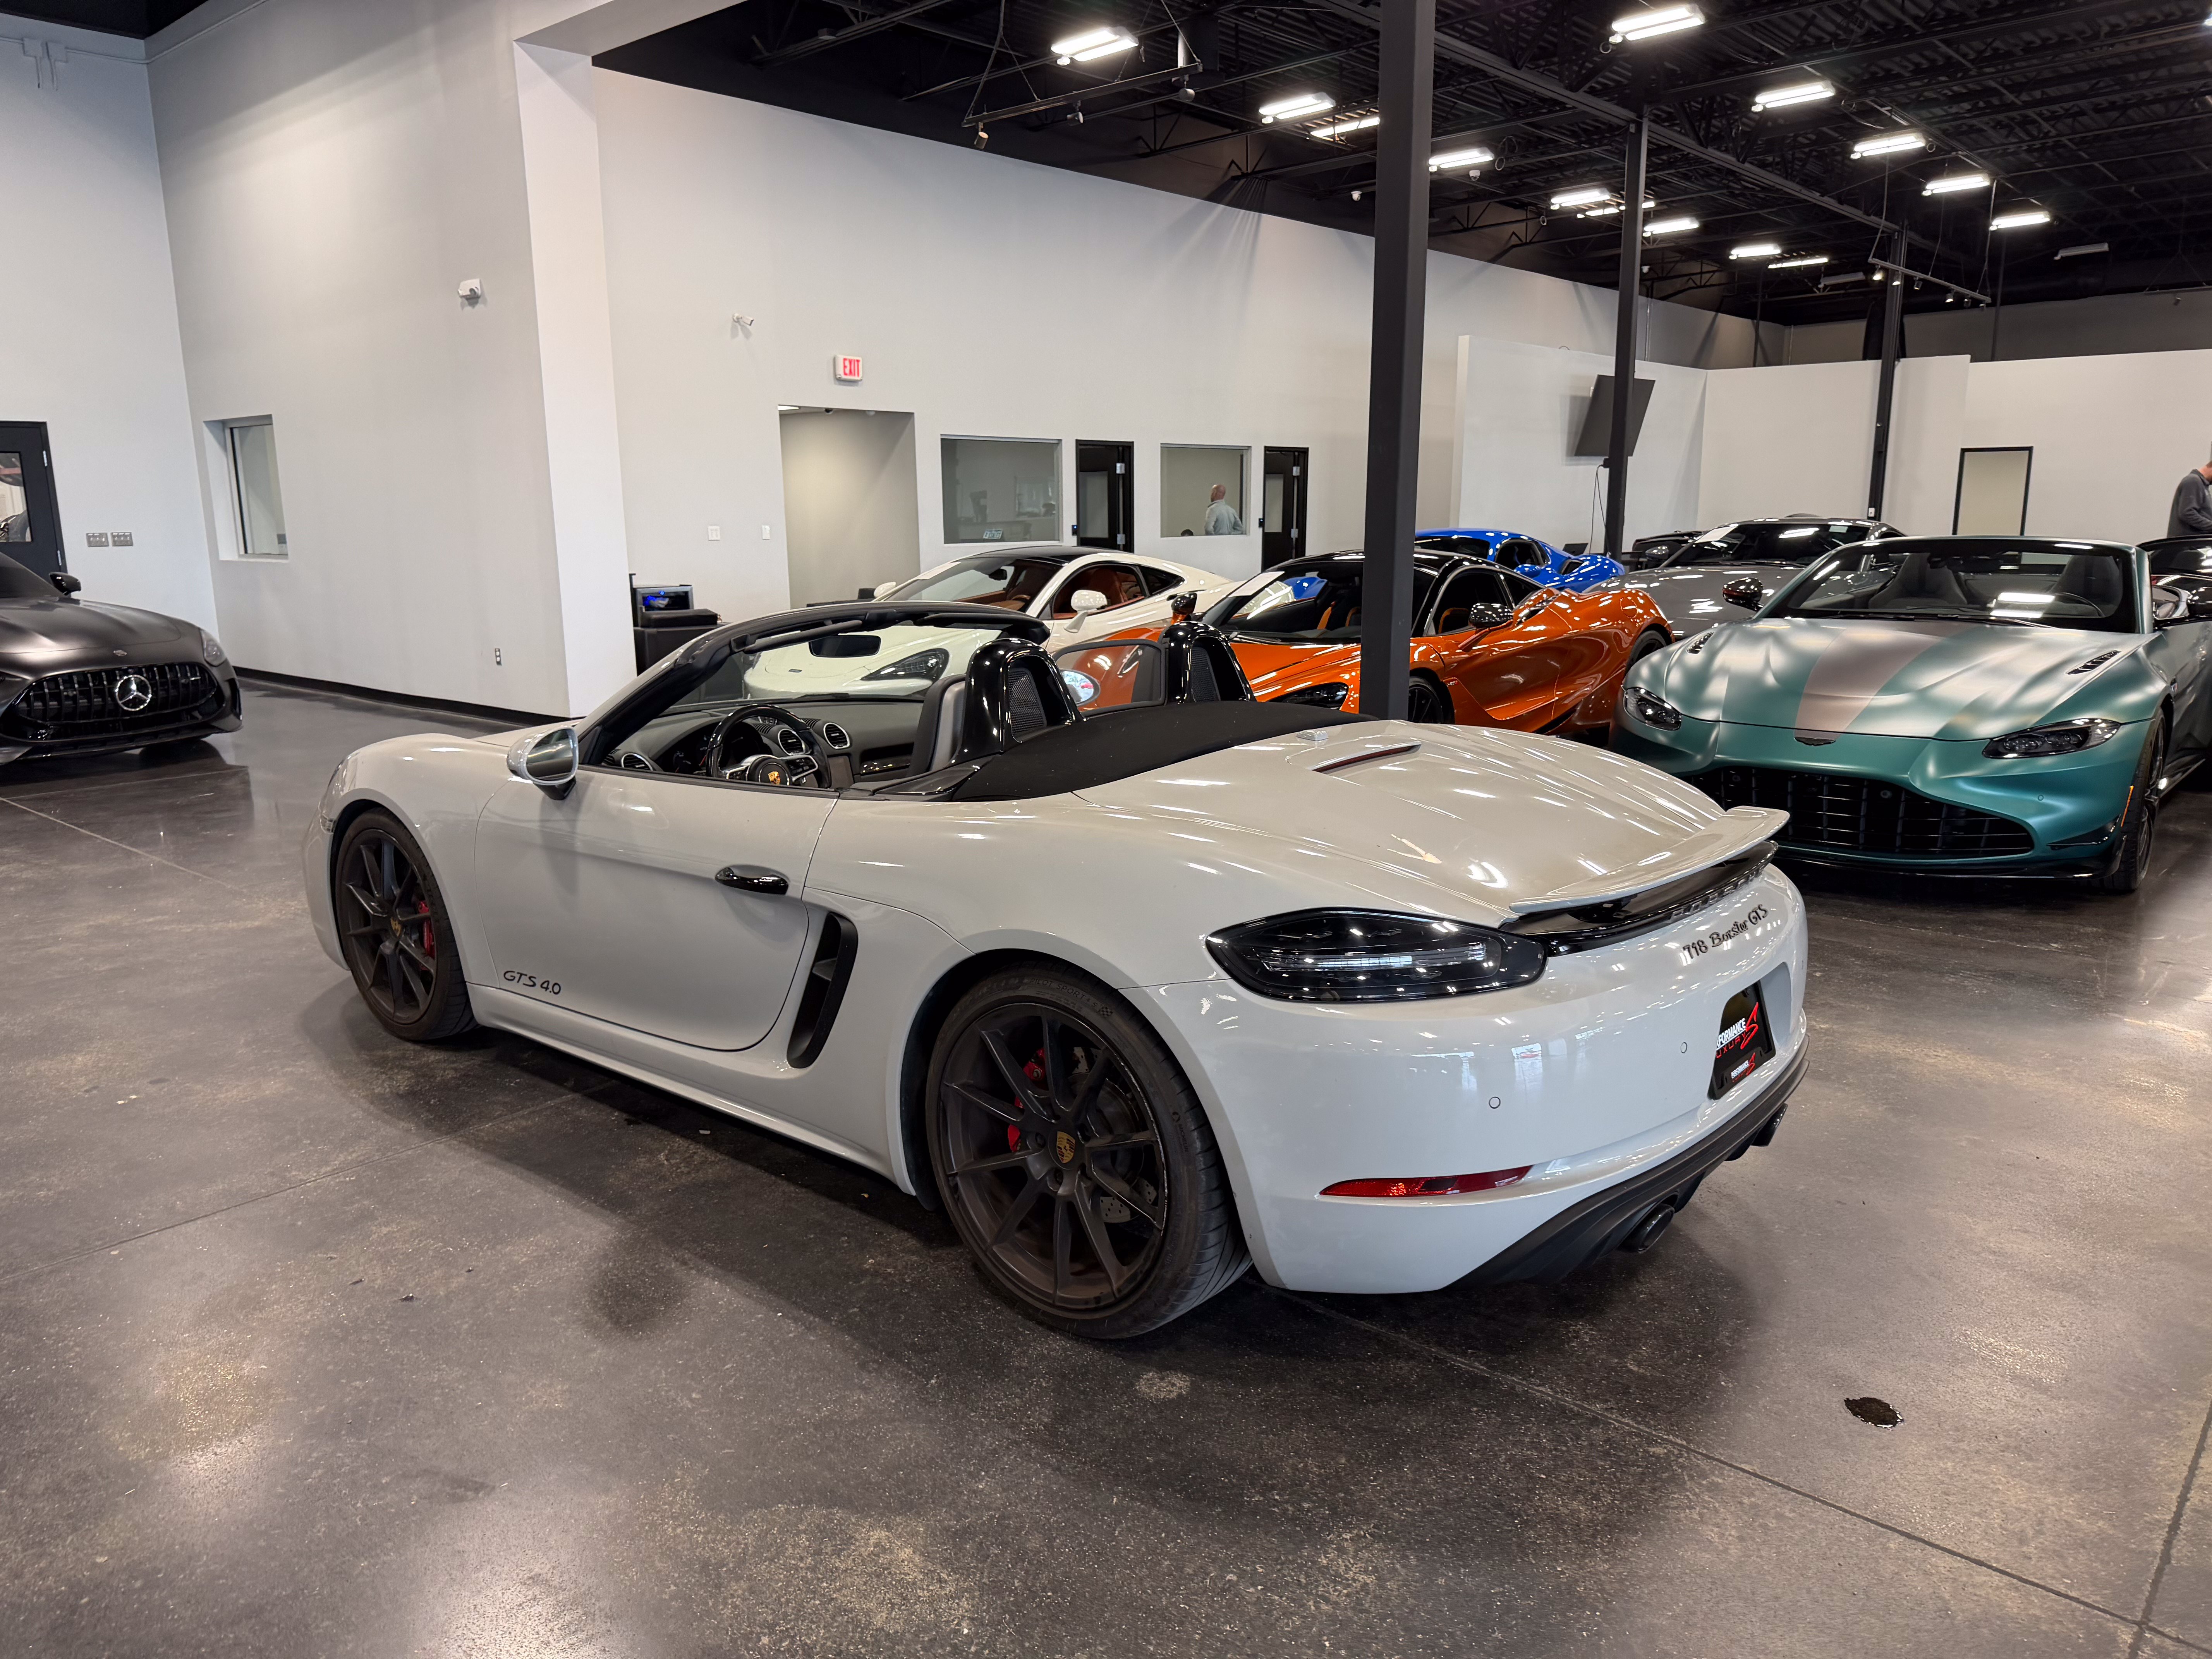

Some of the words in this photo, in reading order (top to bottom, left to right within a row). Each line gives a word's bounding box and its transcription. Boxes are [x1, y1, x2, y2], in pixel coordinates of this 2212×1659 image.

[843, 357, 860, 378] EXIT
[1683, 939, 1708, 959] 718
[1709, 921, 1748, 948] Boxster
[1748, 904, 1769, 925] GTS
[503, 970, 537, 988] GTS
[540, 980, 562, 995] 4.0
[1030, 978, 1054, 987] PILOT
[1056, 984, 1086, 1000] SPORT
